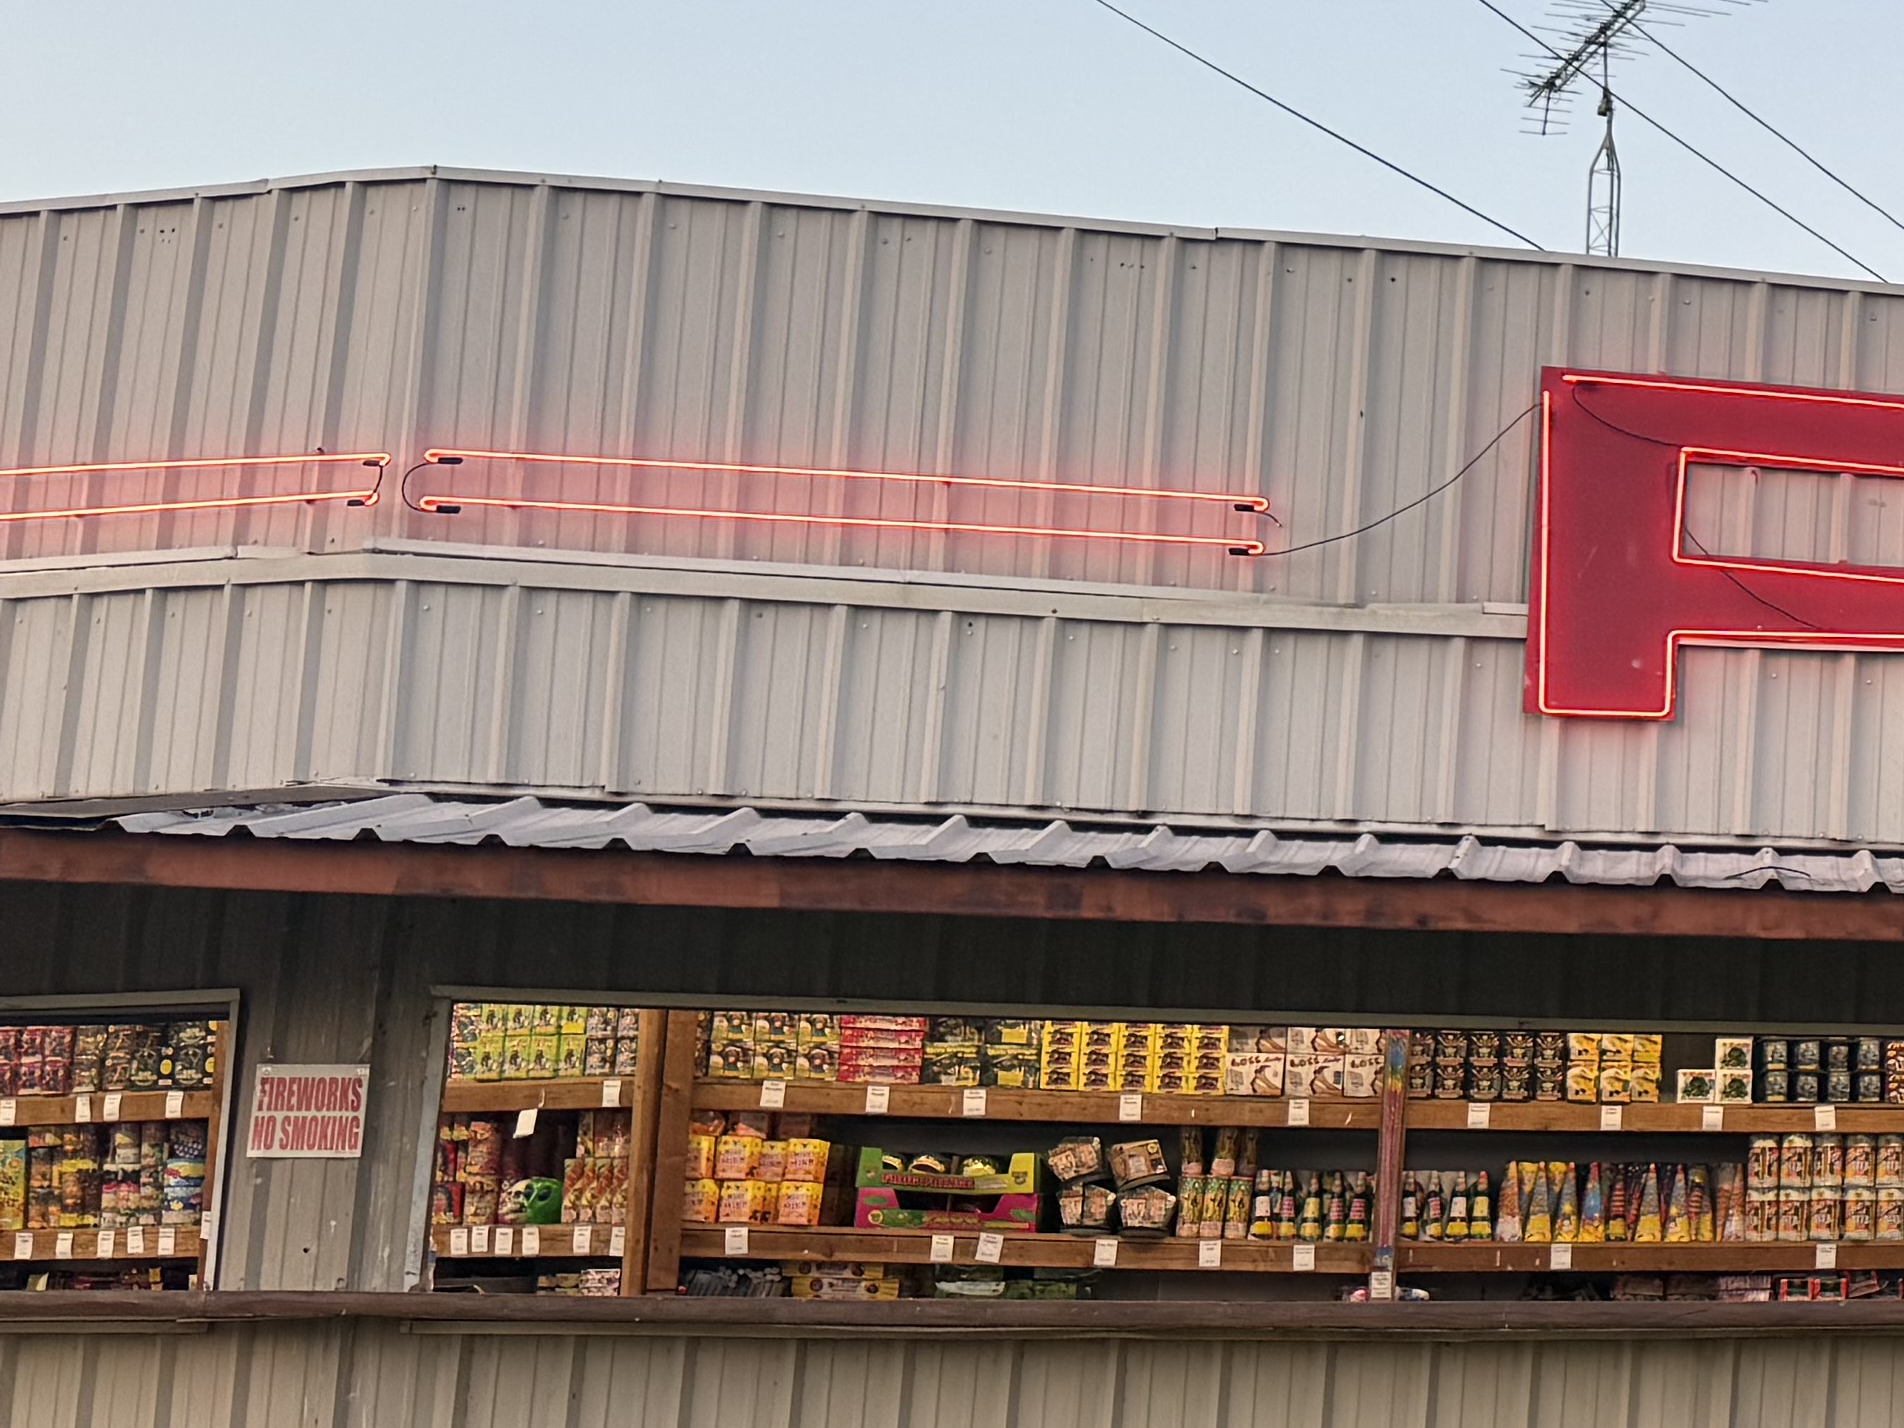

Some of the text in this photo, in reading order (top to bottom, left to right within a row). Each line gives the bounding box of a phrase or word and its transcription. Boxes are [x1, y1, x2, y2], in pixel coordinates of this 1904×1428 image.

[257, 1076, 363, 1112] FIREWORKS
[250, 1115, 361, 1151] NO SMOKING
